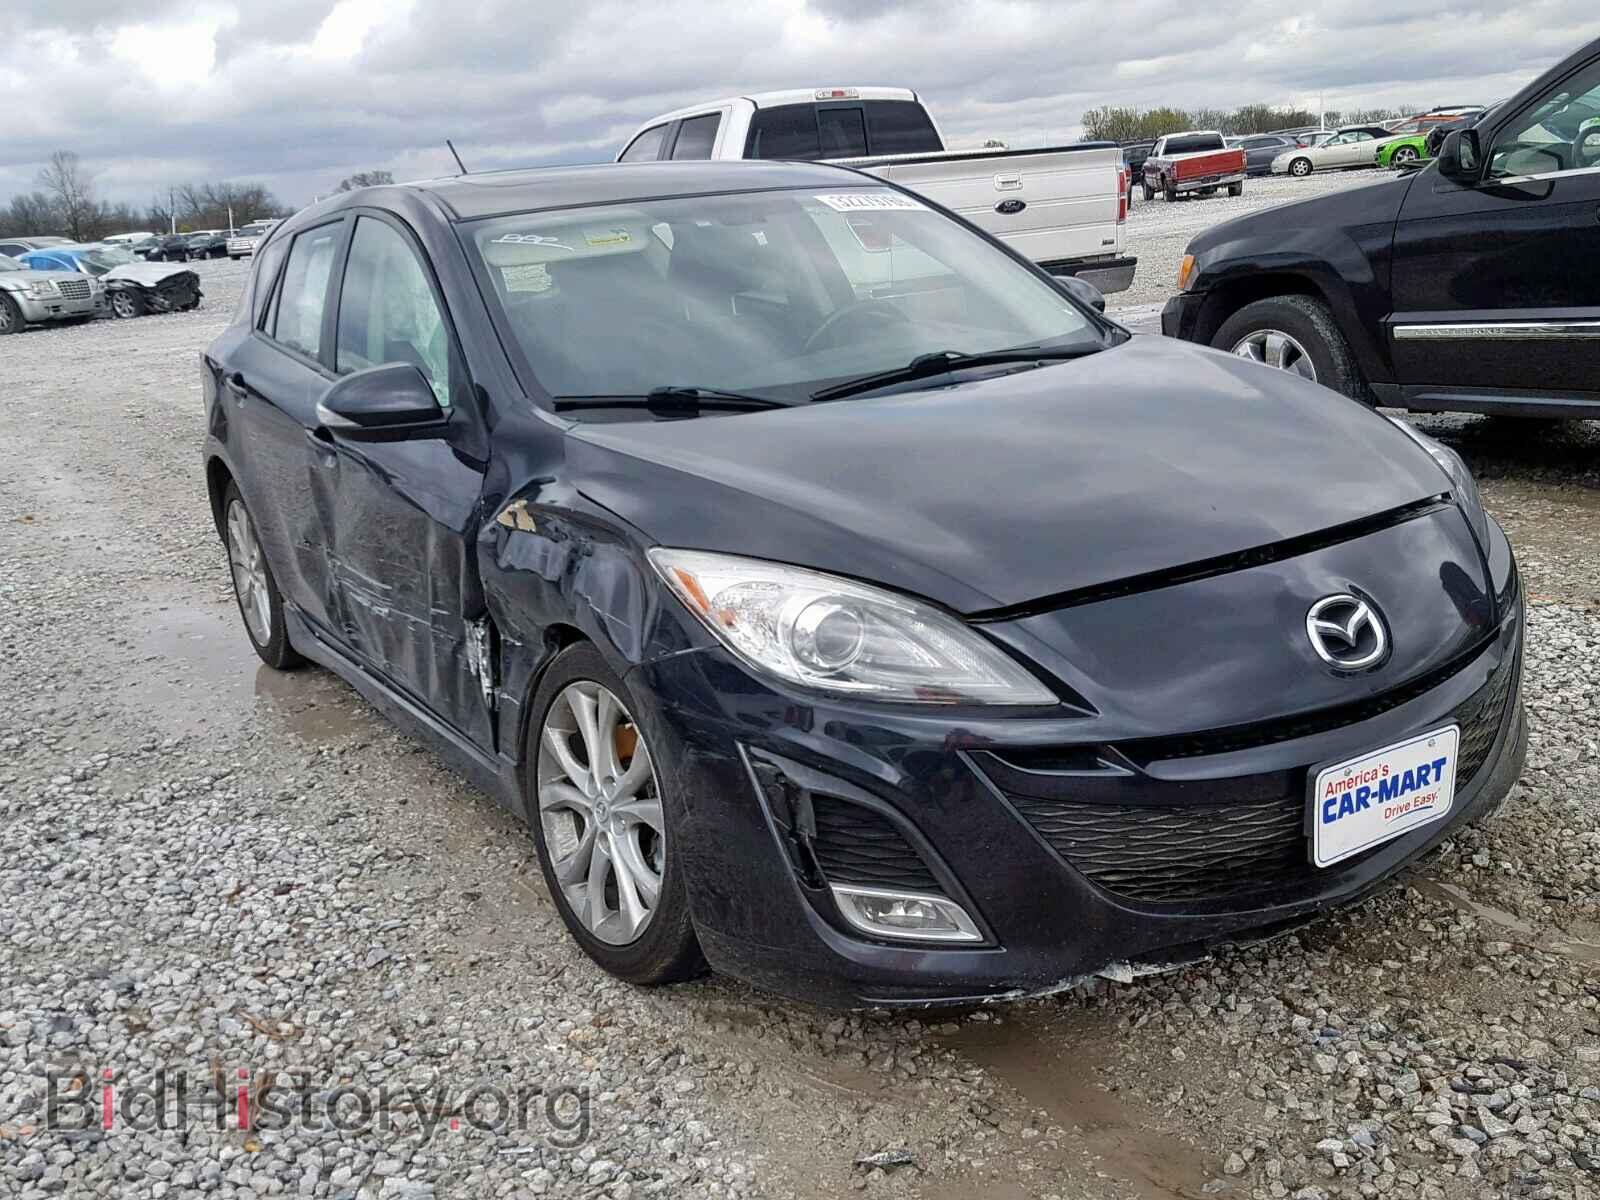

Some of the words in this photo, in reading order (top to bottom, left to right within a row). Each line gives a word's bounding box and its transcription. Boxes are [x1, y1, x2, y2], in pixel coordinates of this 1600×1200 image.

[1322, 757, 1447, 825] CAR-MART
[1325, 764, 1389, 798] America's
[1384, 801, 1410, 819] Drive
